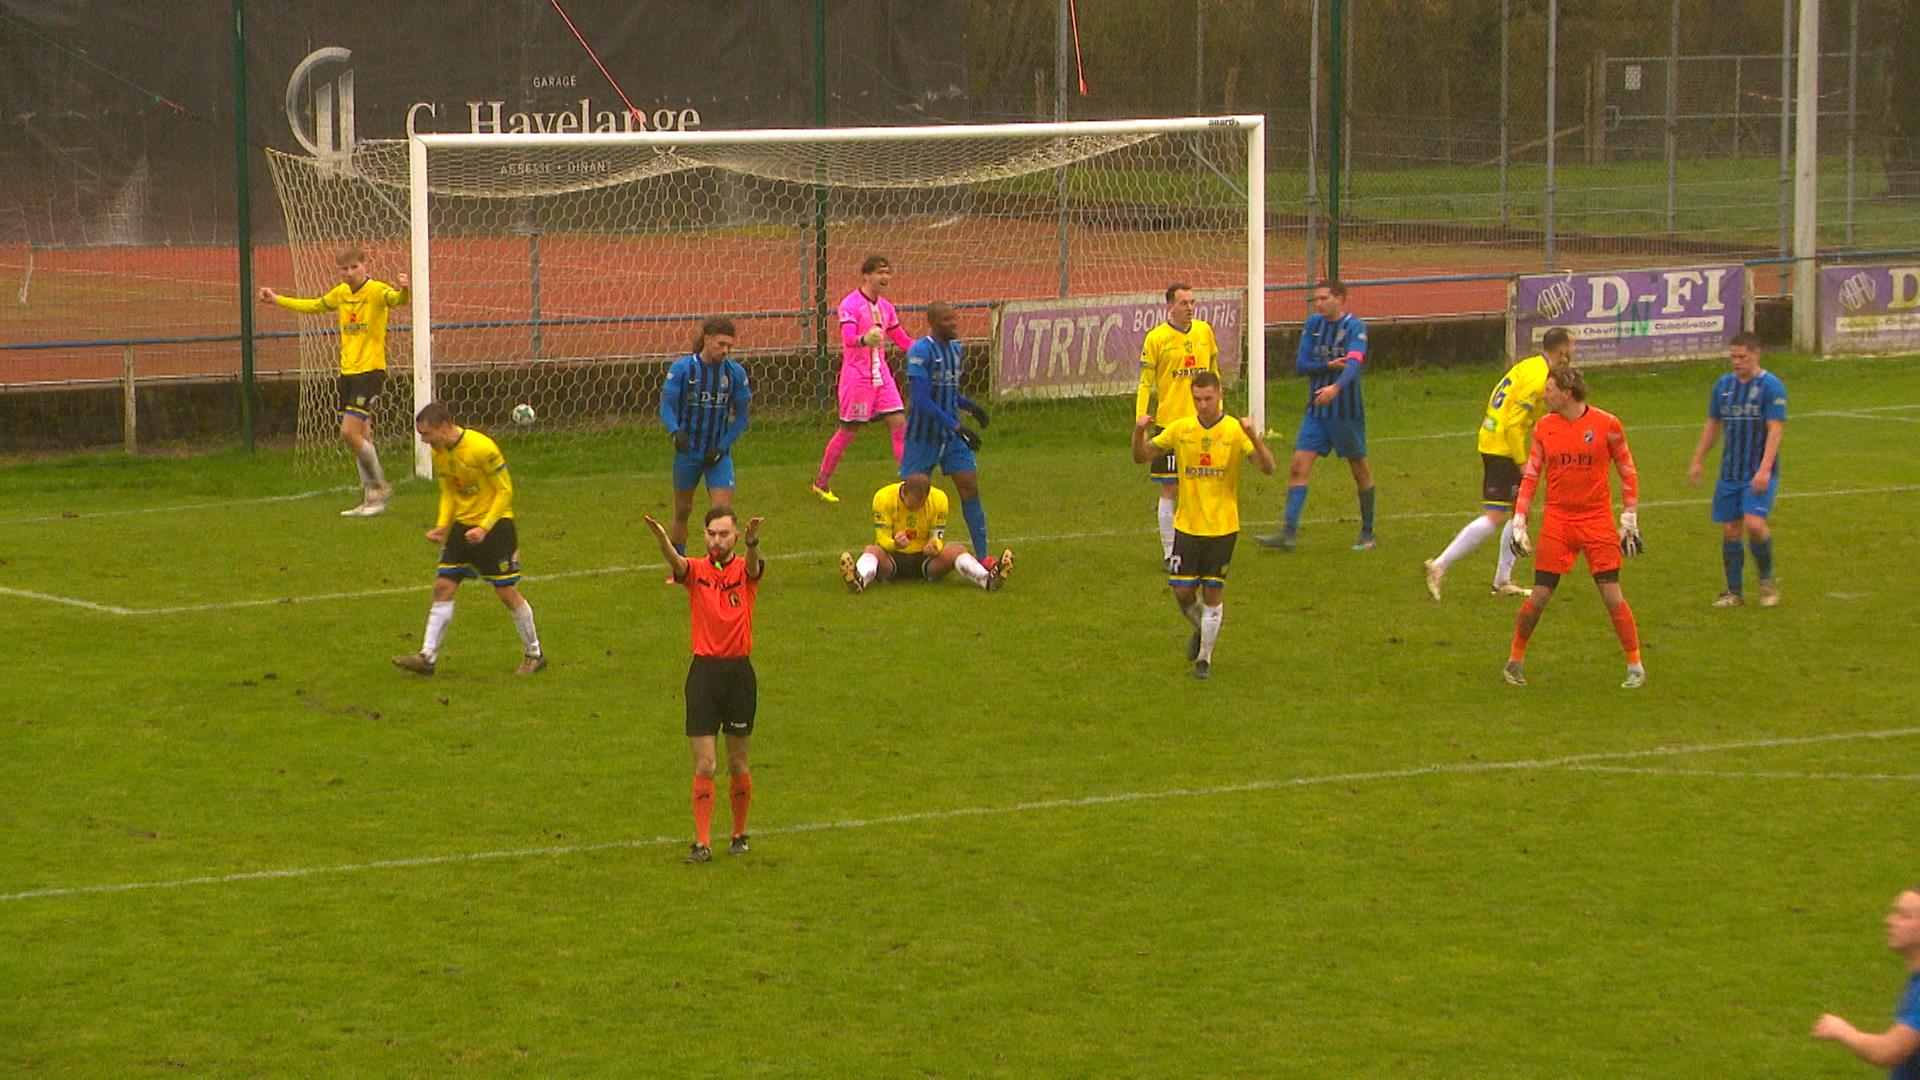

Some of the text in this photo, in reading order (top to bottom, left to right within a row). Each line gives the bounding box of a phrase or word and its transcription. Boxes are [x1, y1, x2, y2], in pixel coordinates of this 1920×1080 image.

[533, 75, 577, 88] GARAGE
[567, 160, 612, 173] DINANT
[1586, 269, 1727, 318] D-FI
[1212, 303, 1237, 329] Fils
[1028, 312, 1123, 379] TRTC
[1491, 377, 1512, 410] 6
[1166, 455, 1176, 471] 11
